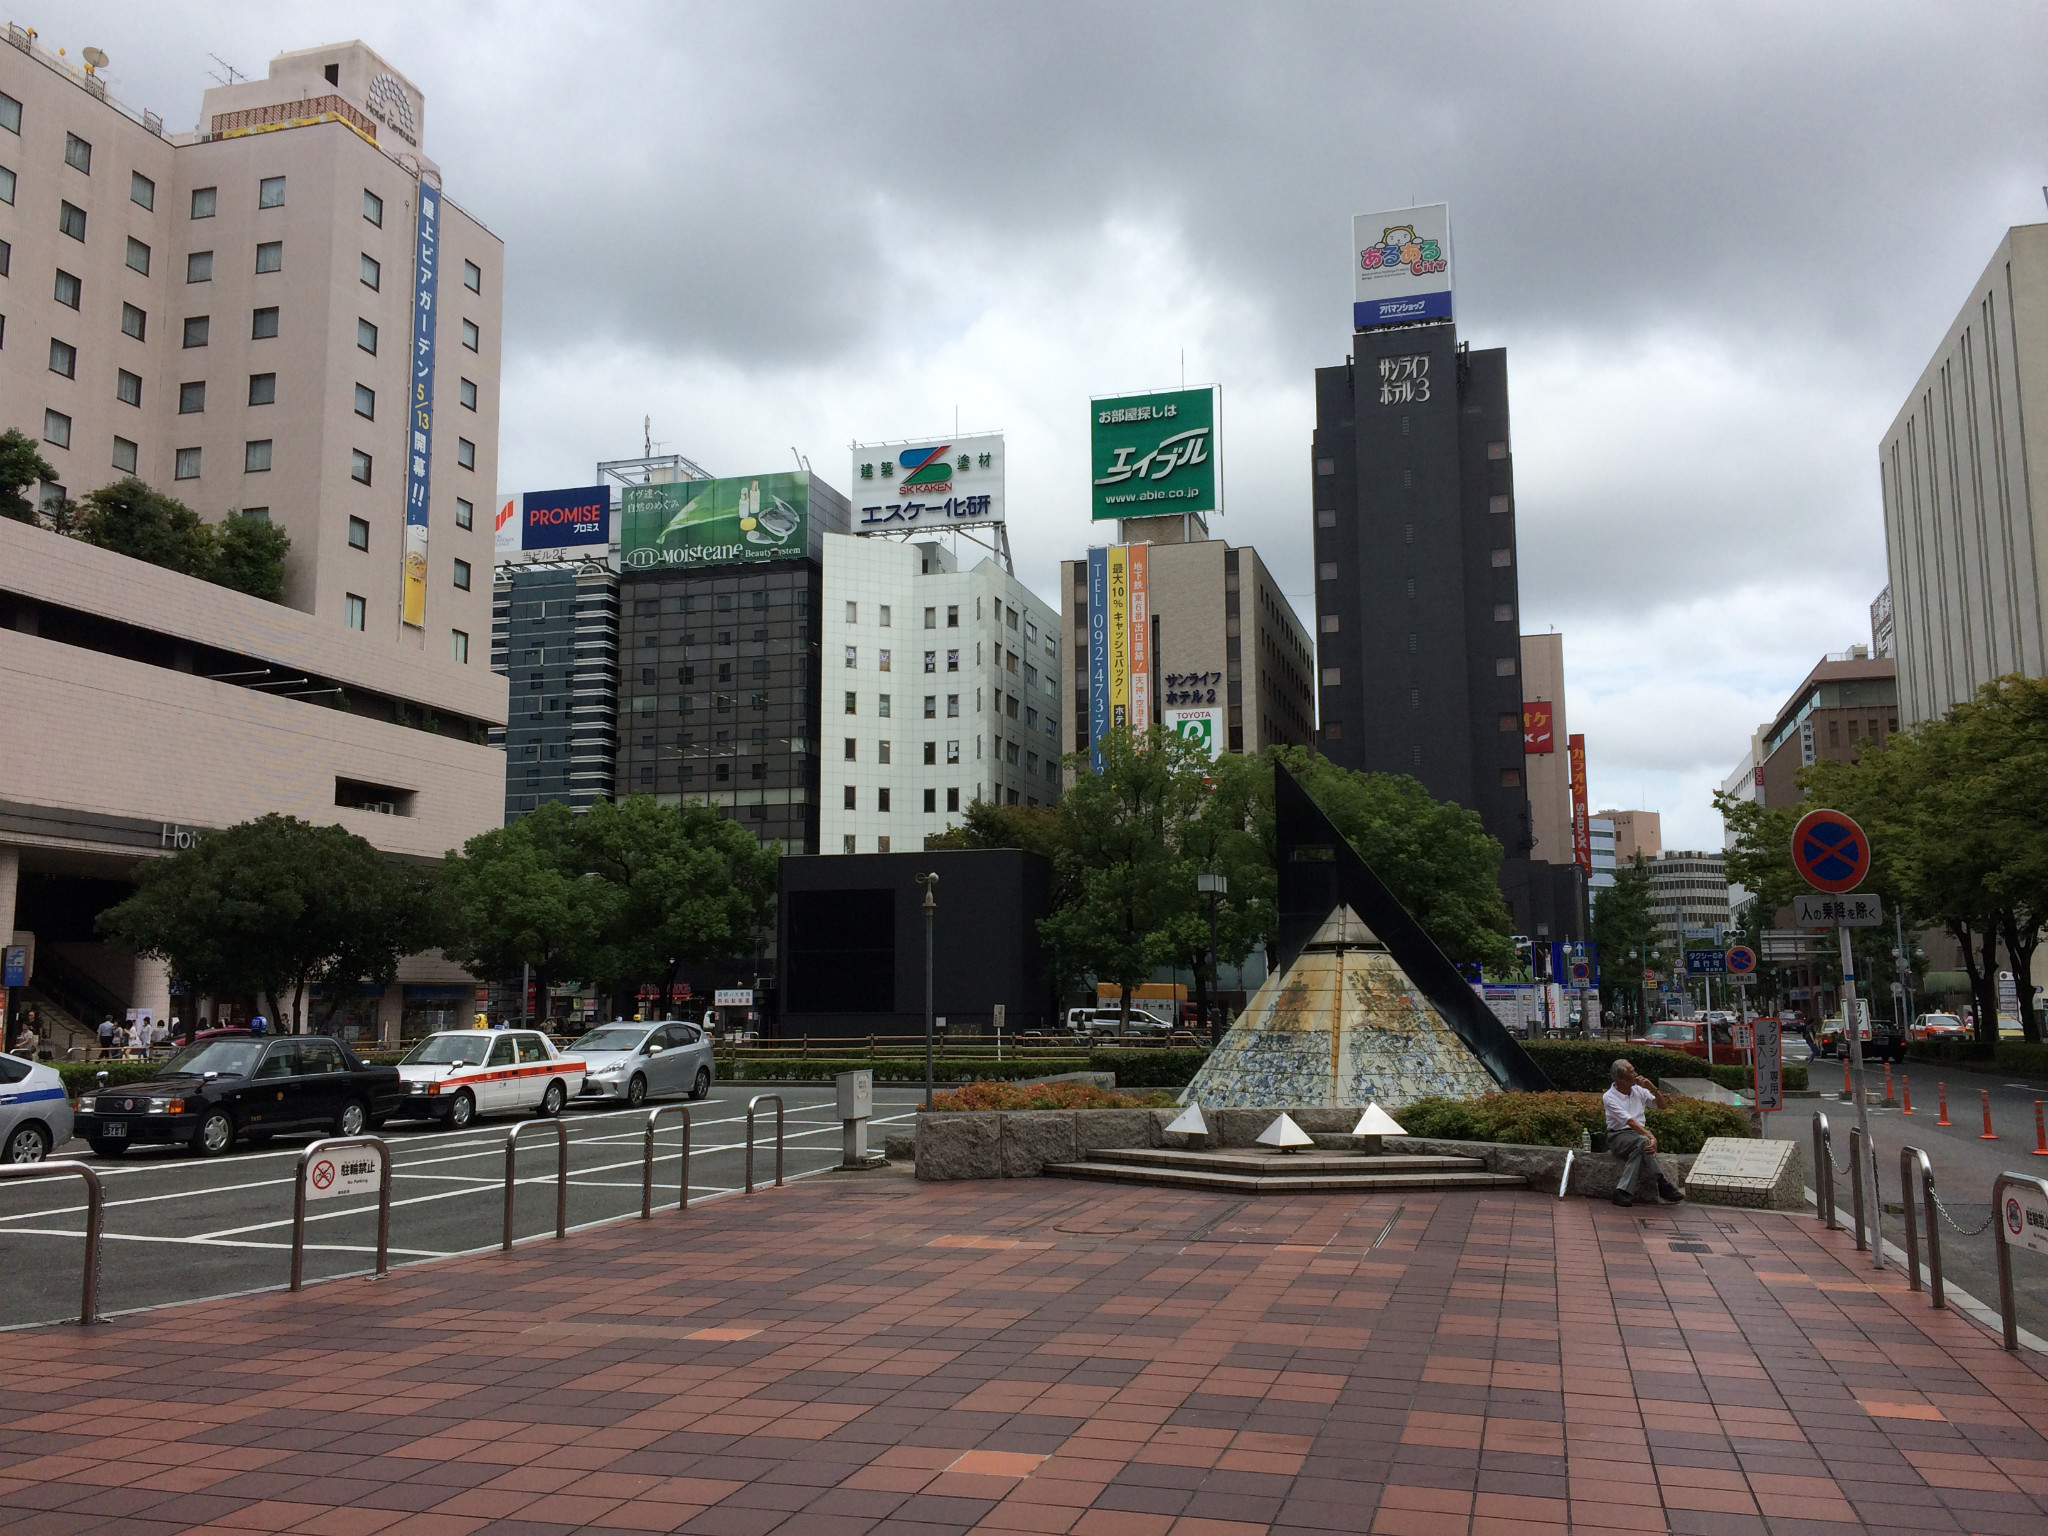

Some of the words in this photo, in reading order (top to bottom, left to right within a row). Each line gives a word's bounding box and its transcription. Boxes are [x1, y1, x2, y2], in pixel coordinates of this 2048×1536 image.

[366, 101, 386, 123] Hotel
[1361, 240, 1441, 270] あるある
[1379, 301, 1425, 314] アパマンショップ
[1379, 356, 1430, 381] サンライフ
[1380, 378, 1431, 405] ホテル3
[1098, 404, 1177, 424] お部屋探しは
[1094, 427, 1209, 485] エイブル
[915, 483, 952, 494] KAKEN
[1105, 487, 1199, 504] www.able.co.jp
[530, 504, 601, 526] PROMISE
[627, 499, 680, 513] 自然のめぐみ
[861, 494, 992, 524] エスケー化研
[573, 523, 599, 533] プロミス
[523, 548, 567, 561] 当ビル2F
[745, 549, 771, 558] Beauty
[774, 547, 801, 557] ystem
[1094, 564, 1102, 606] TEL
[1165, 671, 1222, 687] サンライフ
[1166, 688, 1216, 705] ホテル2
[1176, 711, 1211, 719] TOYOTA
[1573, 748, 1585, 795] カラオケ
[1576, 802, 1587, 849] SHIDAX
[1802, 901, 1876, 920] 人の乗降を除く
[1756, 1034, 1767, 1095] 進入レーン
[1769, 1021, 1778, 1094] タクシー専用
[341, 1161, 375, 1176] 駐輪禁止
